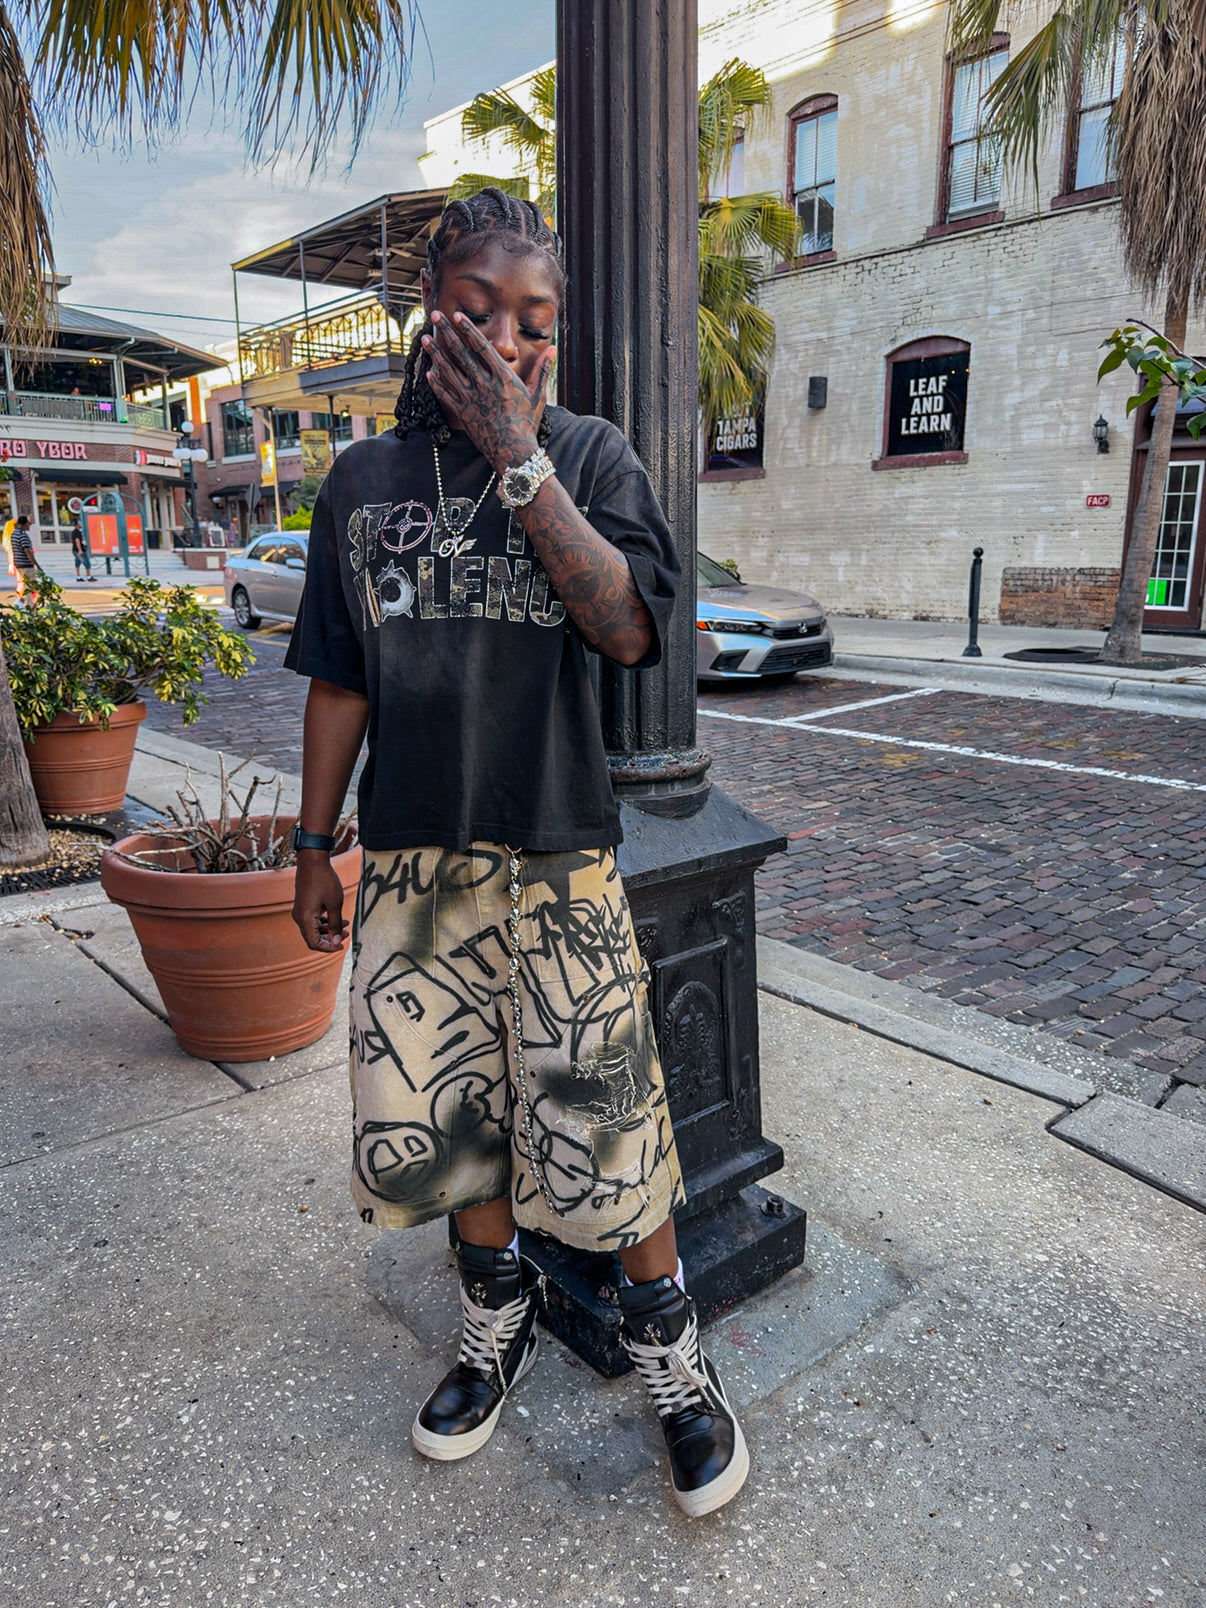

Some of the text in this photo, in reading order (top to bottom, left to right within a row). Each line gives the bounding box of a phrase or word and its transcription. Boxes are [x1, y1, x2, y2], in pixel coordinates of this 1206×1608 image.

[909, 375, 948, 397] LEAF
[911, 395, 944, 415] AND
[717, 416, 757, 436] TAMPA
[901, 413, 952, 436] LEARN
[36, 442, 88, 460] YBOR
[716, 433, 758, 452] CIGARS
[1087, 496, 1109, 506] FACP
[353, 556, 567, 632] VIOLENC
